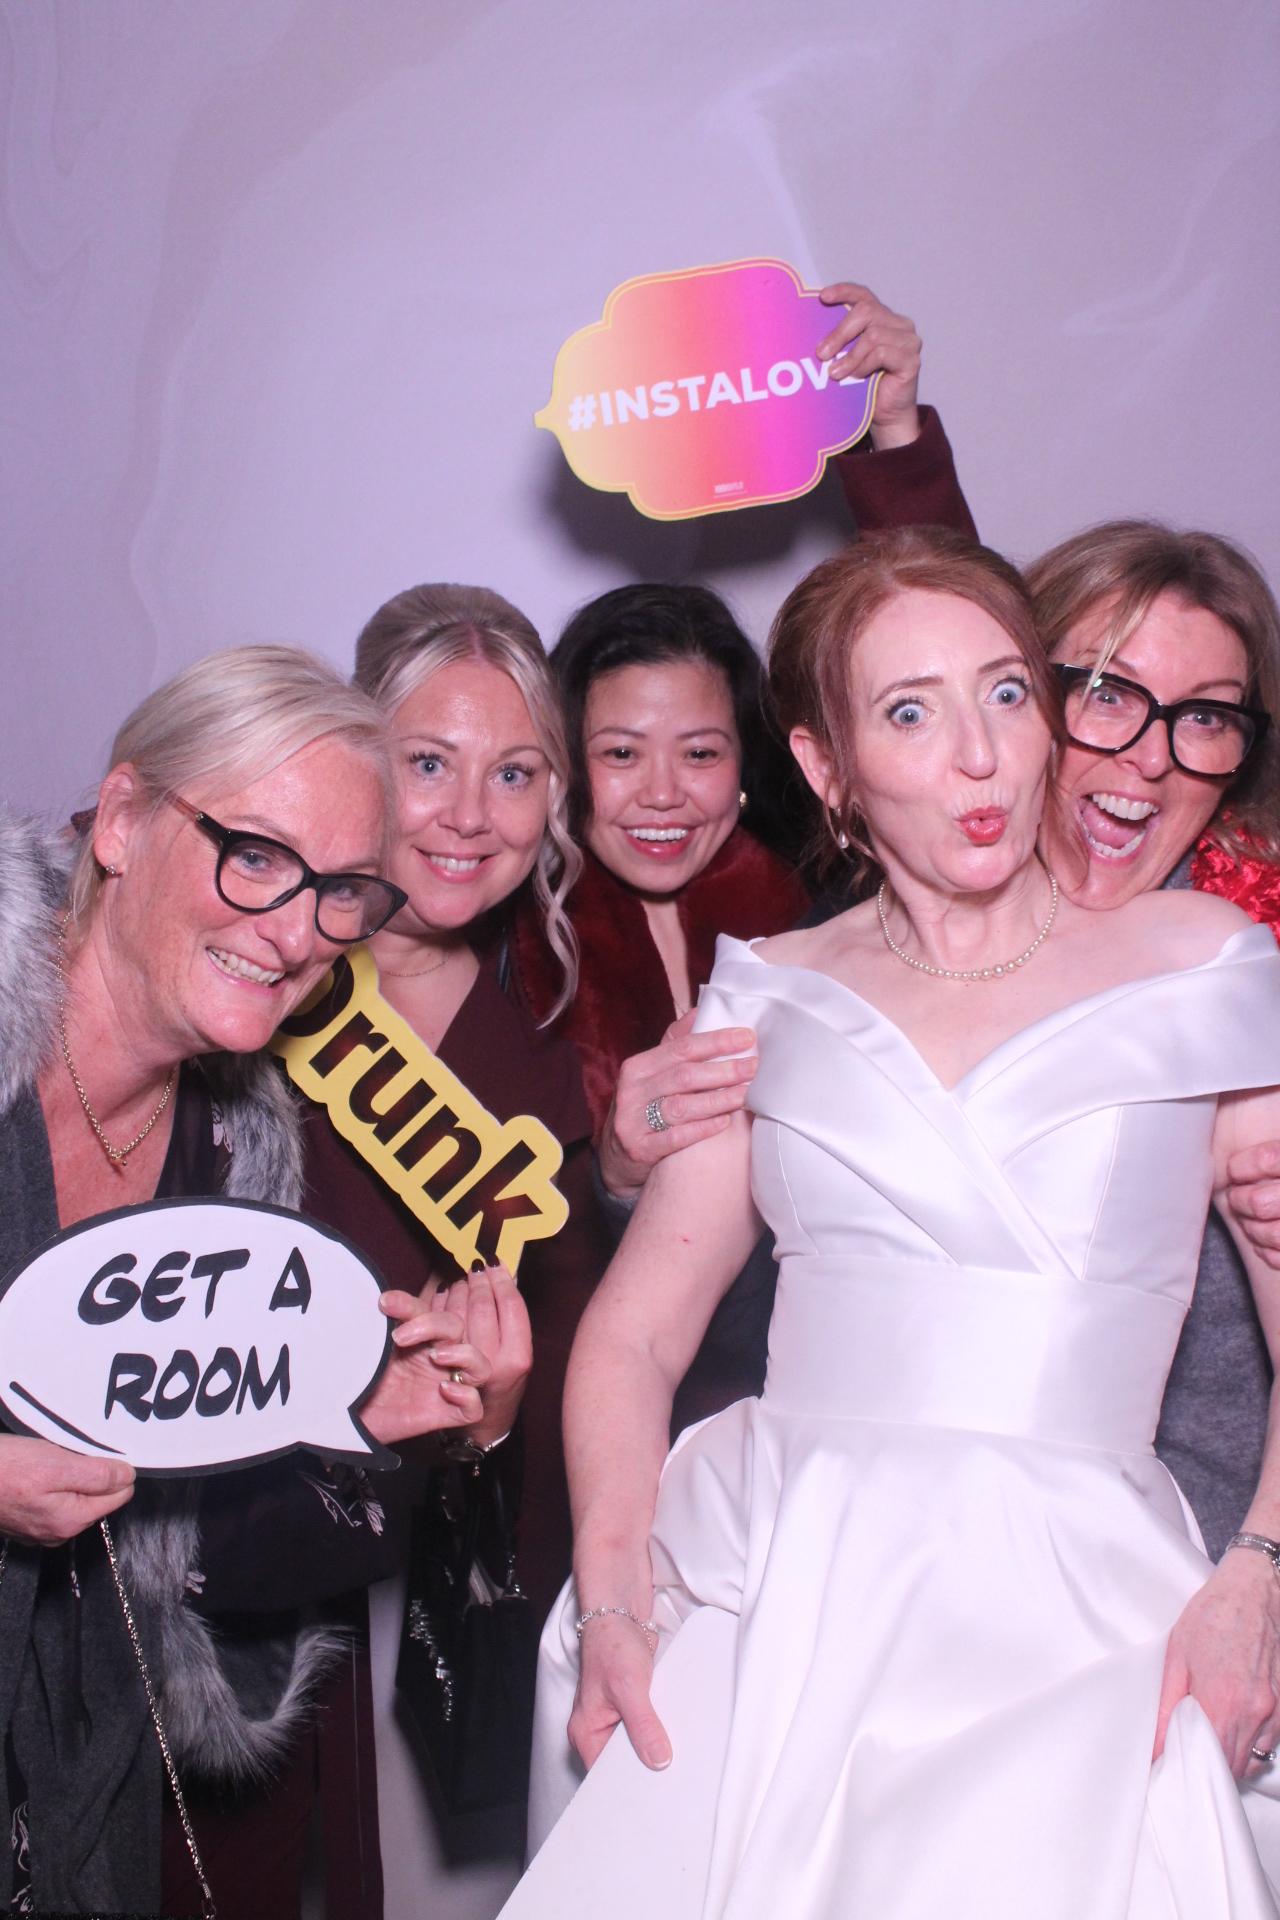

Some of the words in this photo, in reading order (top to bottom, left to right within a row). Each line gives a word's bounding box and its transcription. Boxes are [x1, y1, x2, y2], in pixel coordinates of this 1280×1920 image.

[78, 1248, 250, 1325] GET
[269, 1247, 311, 1314] A
[105, 1343, 290, 1422] ROOM
